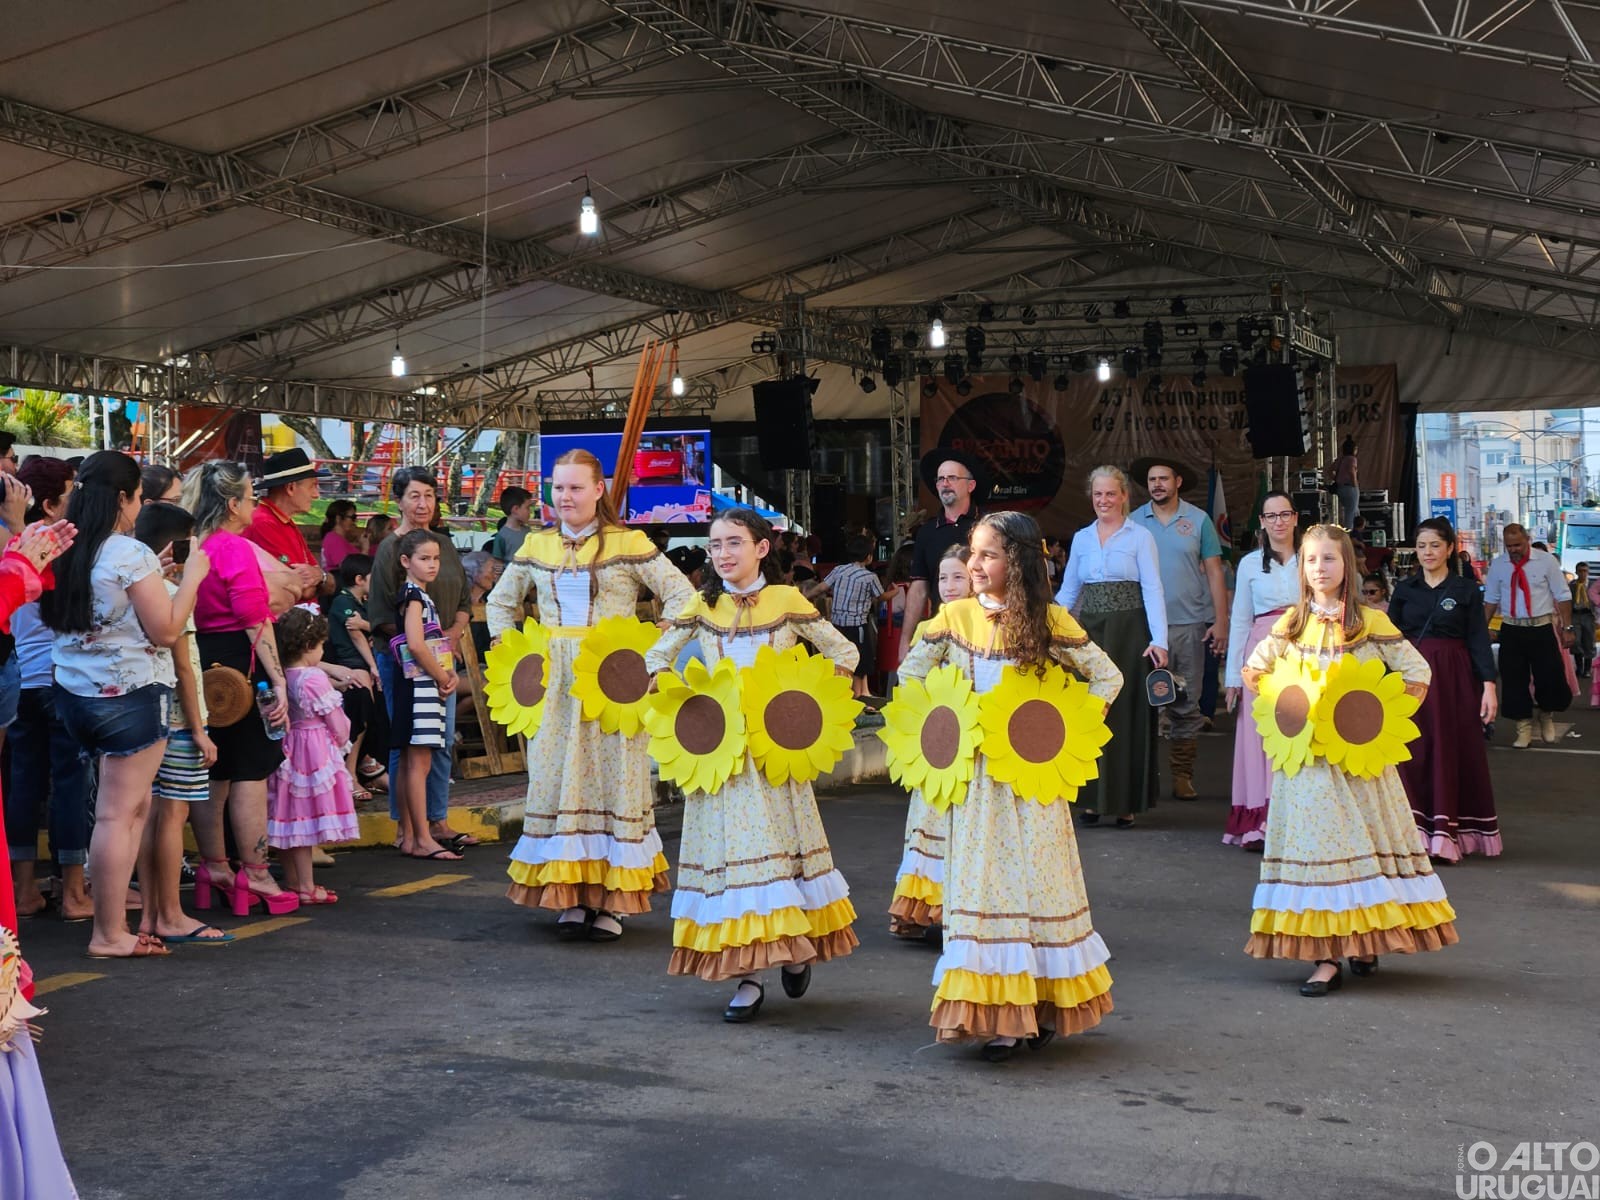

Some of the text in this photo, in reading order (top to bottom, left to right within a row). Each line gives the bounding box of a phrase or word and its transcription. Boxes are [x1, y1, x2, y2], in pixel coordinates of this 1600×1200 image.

[1143, 387, 1248, 409] Acampame
[1093, 412, 1114, 431] de
[1124, 411, 1219, 431] Frederico
